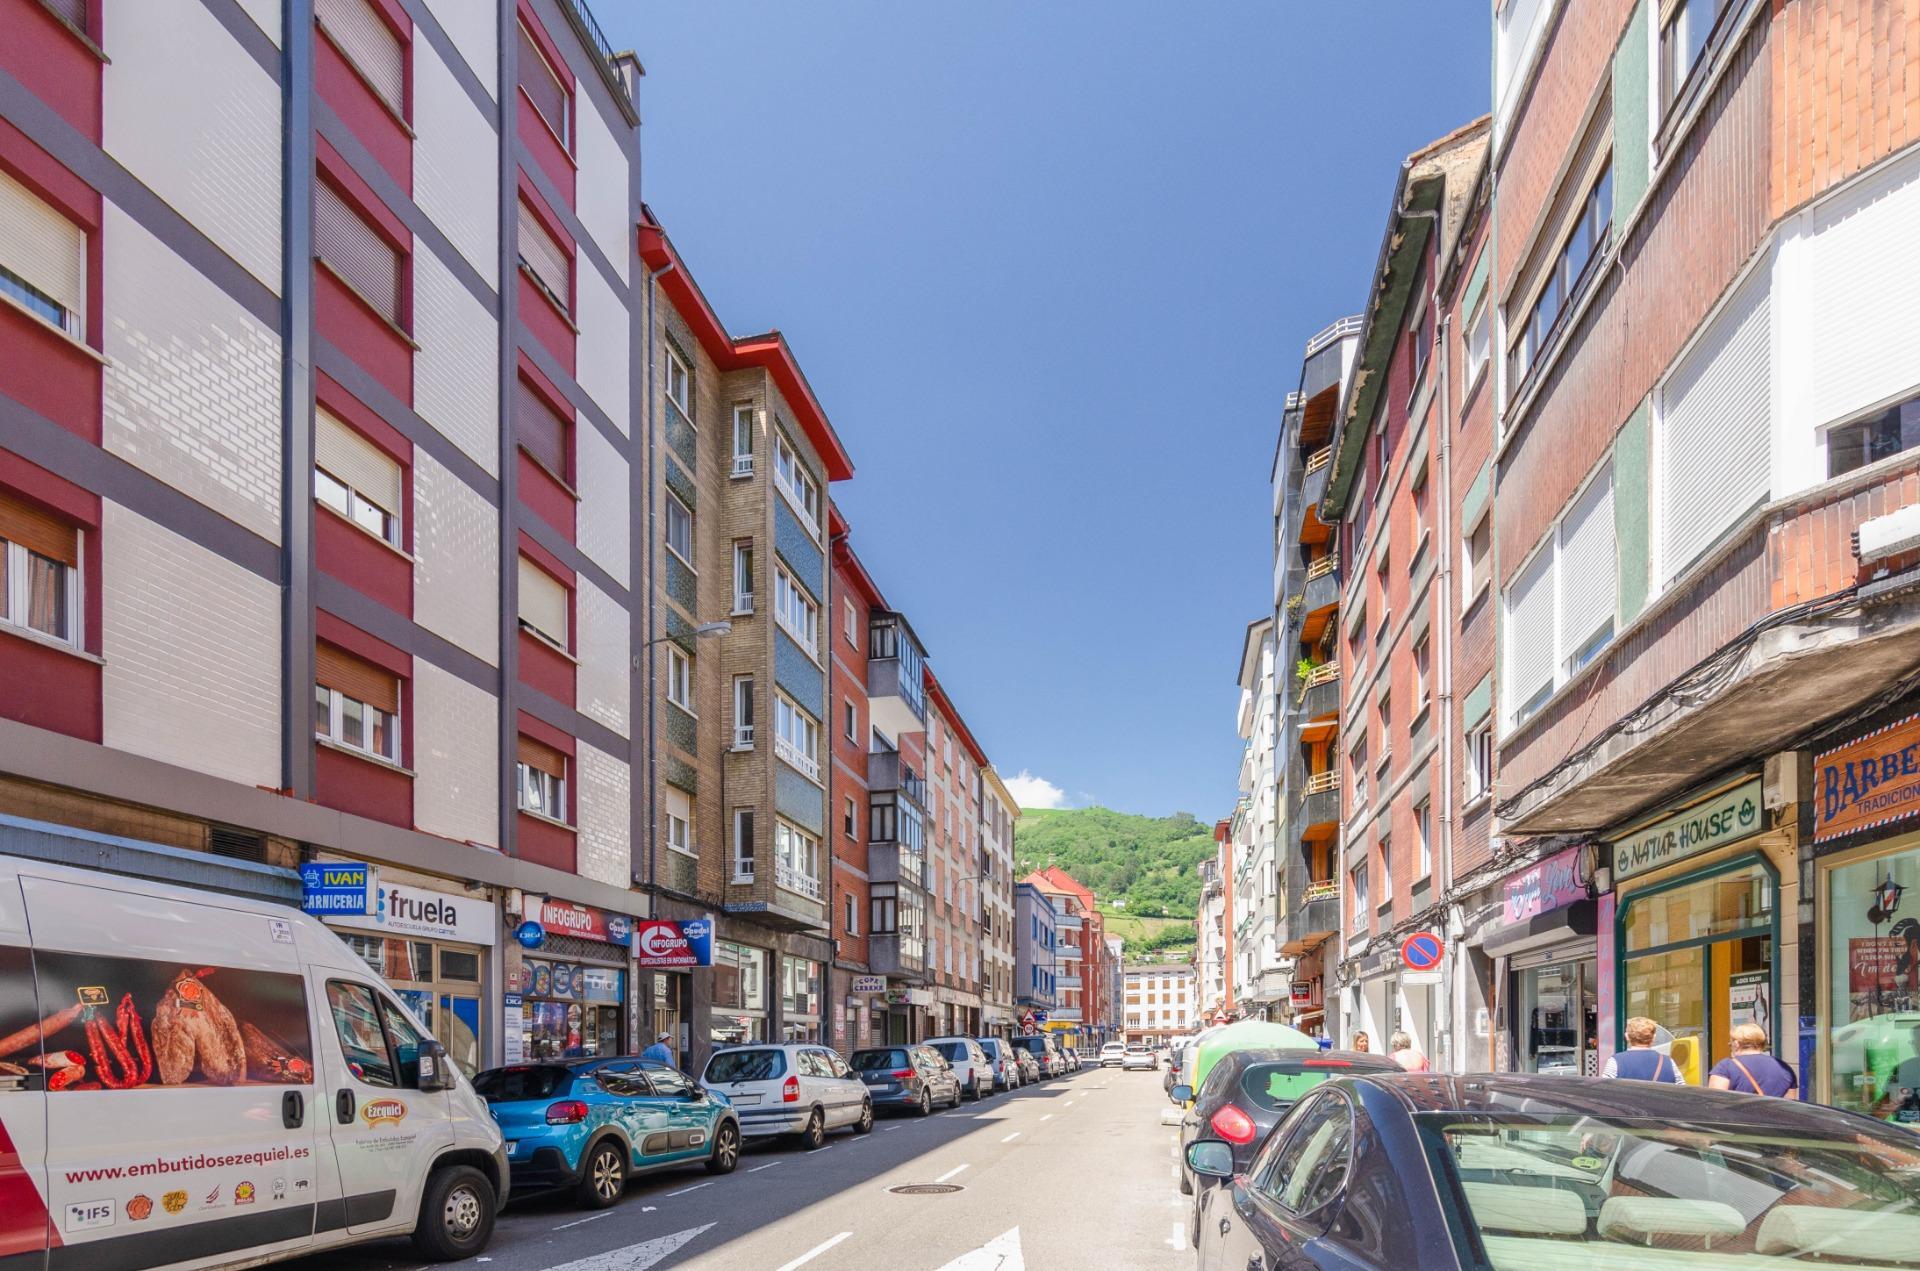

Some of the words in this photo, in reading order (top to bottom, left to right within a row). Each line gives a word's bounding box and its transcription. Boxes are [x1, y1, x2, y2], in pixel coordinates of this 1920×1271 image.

[1823, 741, 1920, 823] BARBE
[1630, 829, 1677, 868] NATUR
[1679, 805, 1735, 849] HOUSE
[324, 871, 364, 886] IVAN
[302, 894, 364, 909] CARNICERIA
[389, 889, 457, 926] fruela
[543, 905, 592, 931] INFOGRUPO
[651, 938, 688, 949] INFOGRUPO
[367, 1103, 402, 1118] Ezequiel
[65, 1145, 310, 1184] www.embutidosezequiel.es
[87, 1205, 110, 1220] IFS
